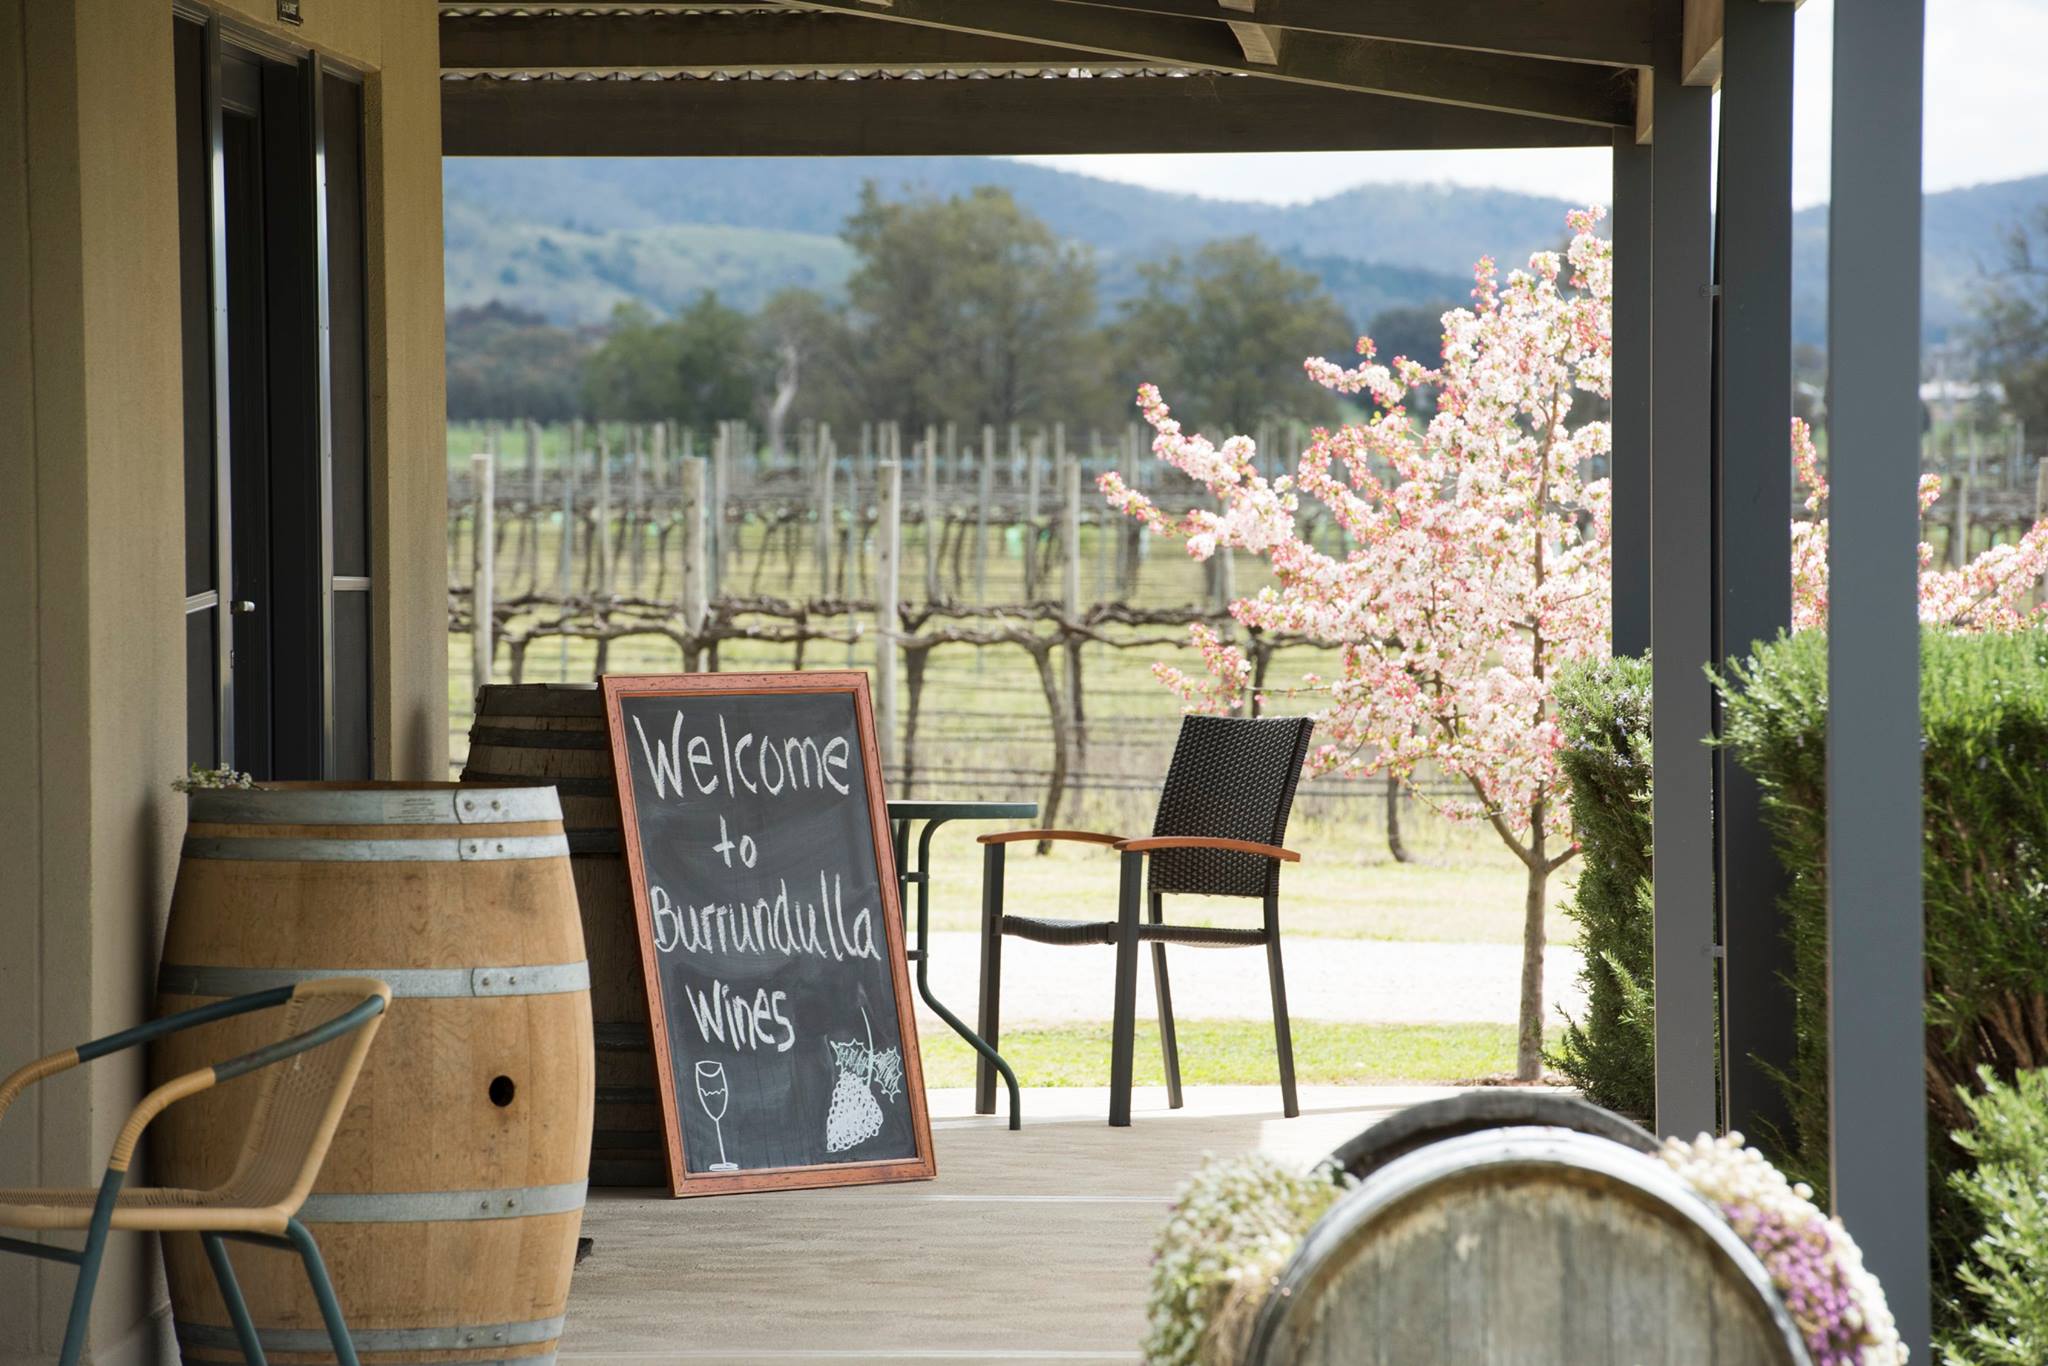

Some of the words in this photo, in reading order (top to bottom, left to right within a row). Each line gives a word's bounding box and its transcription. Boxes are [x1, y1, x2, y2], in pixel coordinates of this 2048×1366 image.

[632, 710, 849, 799] Welcome
[712, 814, 757, 868] to
[651, 870, 881, 961] Burrundulla
[685, 979, 795, 1052] Wines
